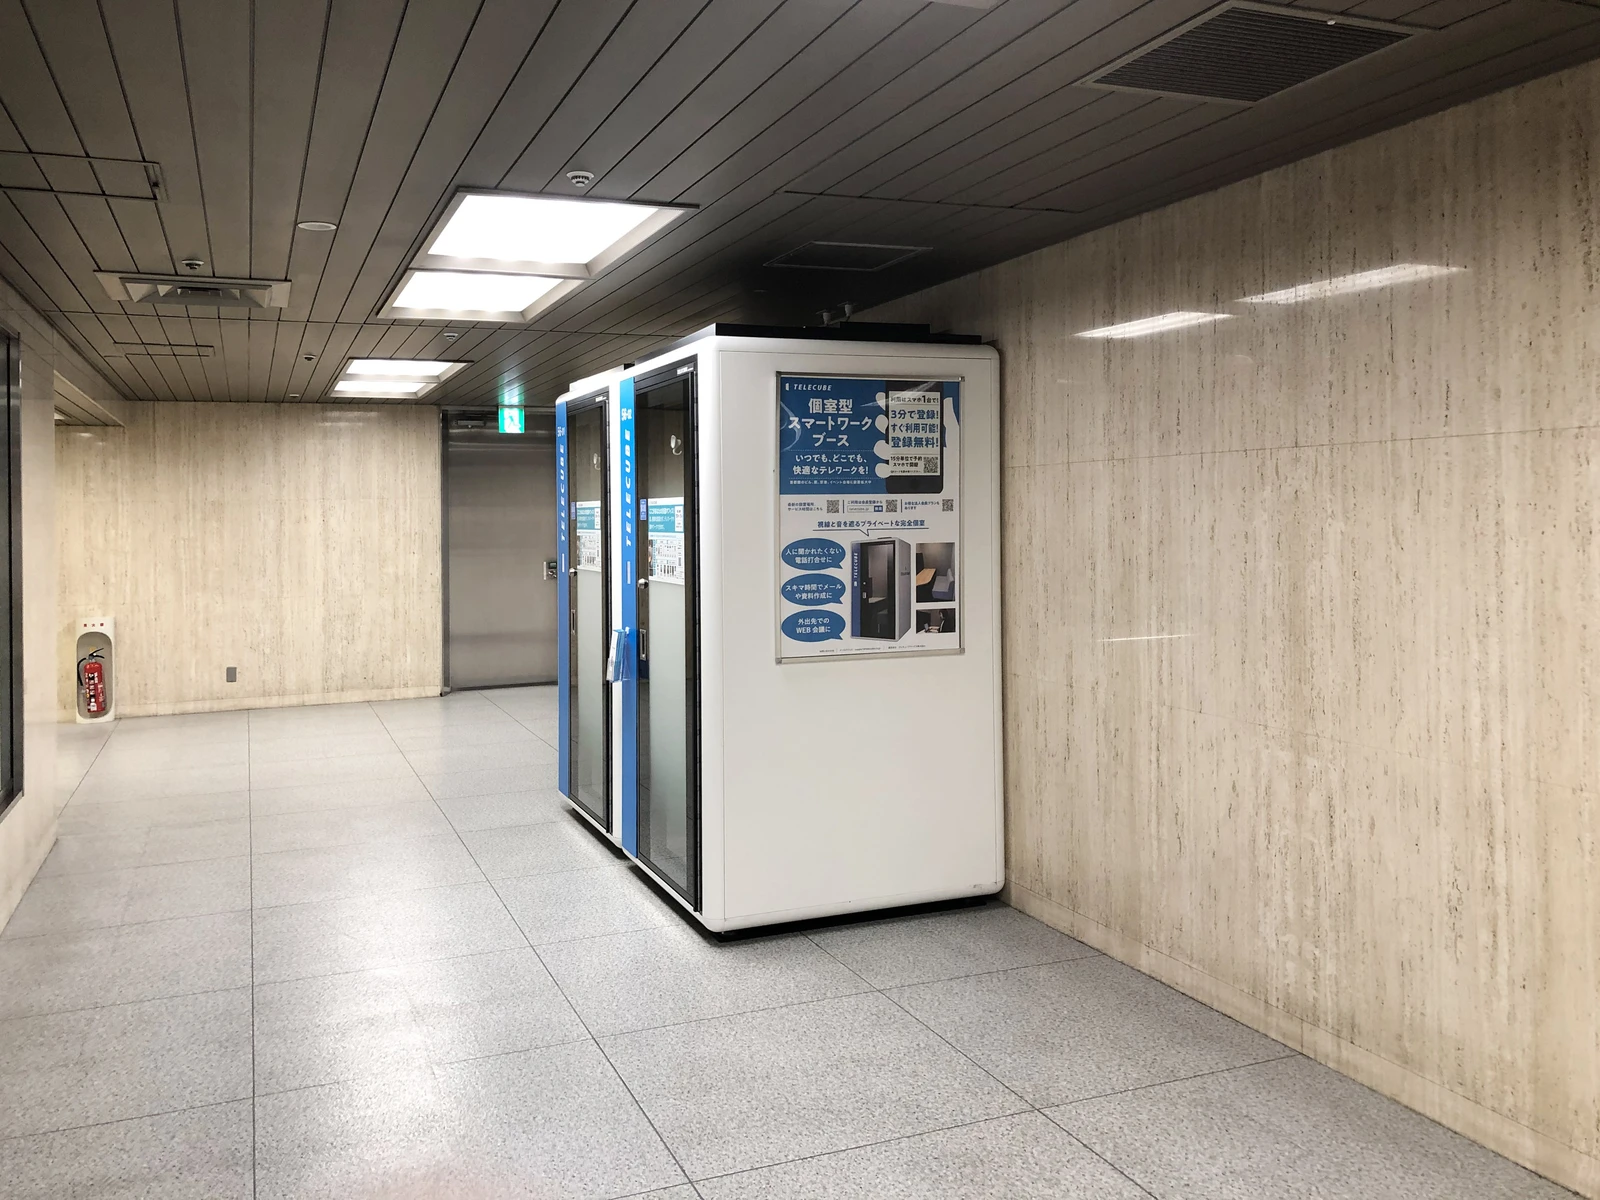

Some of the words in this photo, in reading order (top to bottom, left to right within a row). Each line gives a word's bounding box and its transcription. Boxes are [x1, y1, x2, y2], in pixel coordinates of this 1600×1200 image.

[793, 383, 832, 391] TELECUBE
[808, 398, 853, 414] 個室型
[890, 409, 939, 420] 3分で登録!
[788, 415, 872, 431] スマートワーク
[890, 422, 939, 434] すぐ利用可能!
[812, 431, 850, 447] ブース
[890, 436, 939, 448] 登録無料!
[795, 453, 867, 463] いつでも、どこでも、
[792, 465, 869, 475] 快適なテレワークを!
[624, 429, 632, 547] TELECUBE
[785, 547, 842, 556] 人に聞かれたくない
[785, 584, 842, 592] スキマ時間でメール
[795, 592, 833, 600] や資料作成に
[797, 617, 830, 626] 外出先での
